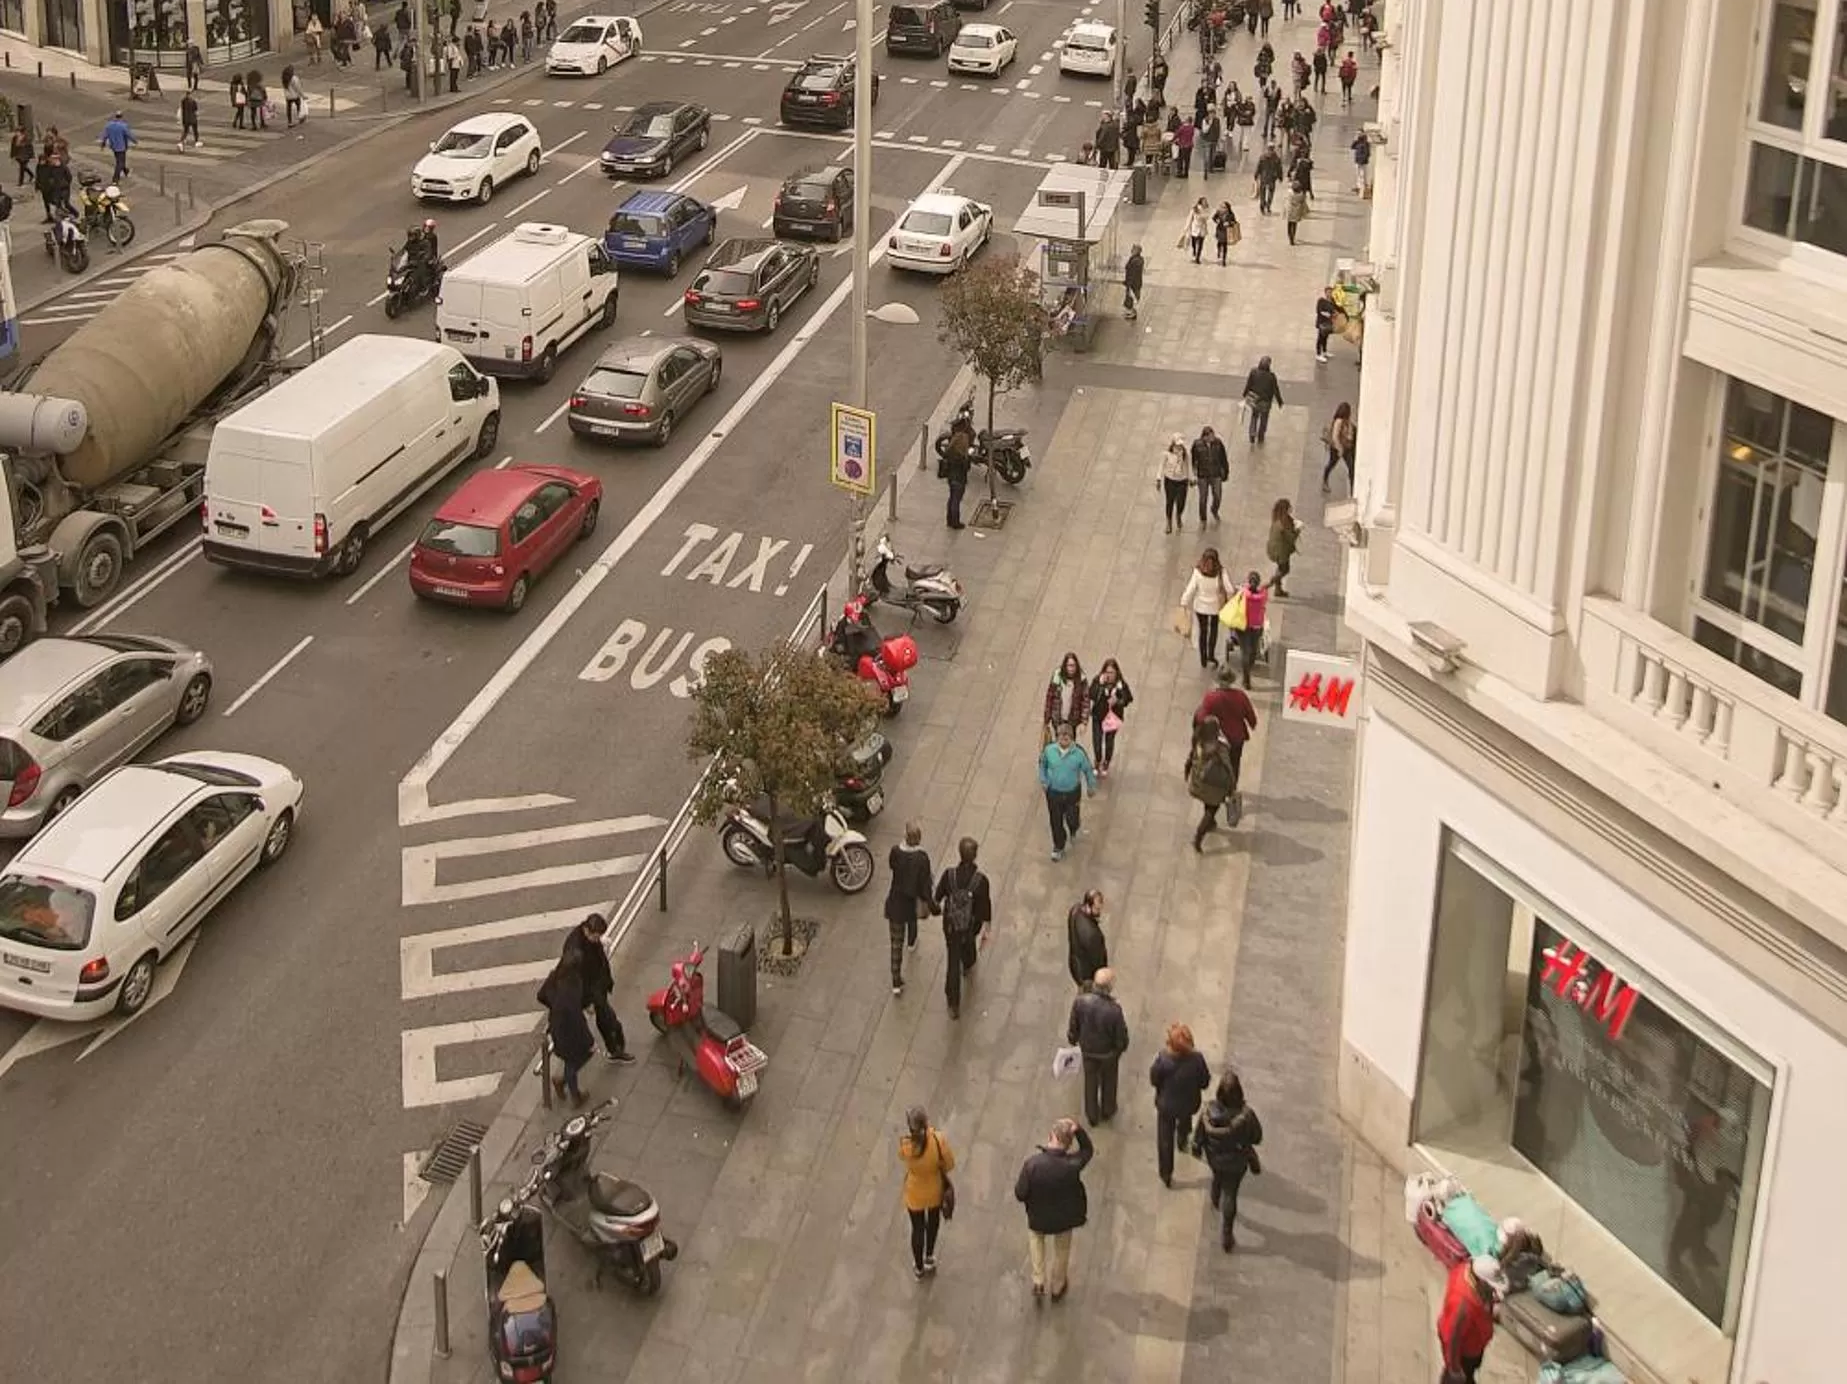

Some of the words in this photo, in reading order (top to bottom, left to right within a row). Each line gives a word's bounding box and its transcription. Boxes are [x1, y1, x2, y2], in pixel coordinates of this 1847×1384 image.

[577, 619, 732, 698] BUS
[1288, 671, 1355, 718] H&M
[1541, 938, 1638, 1041] H&M
